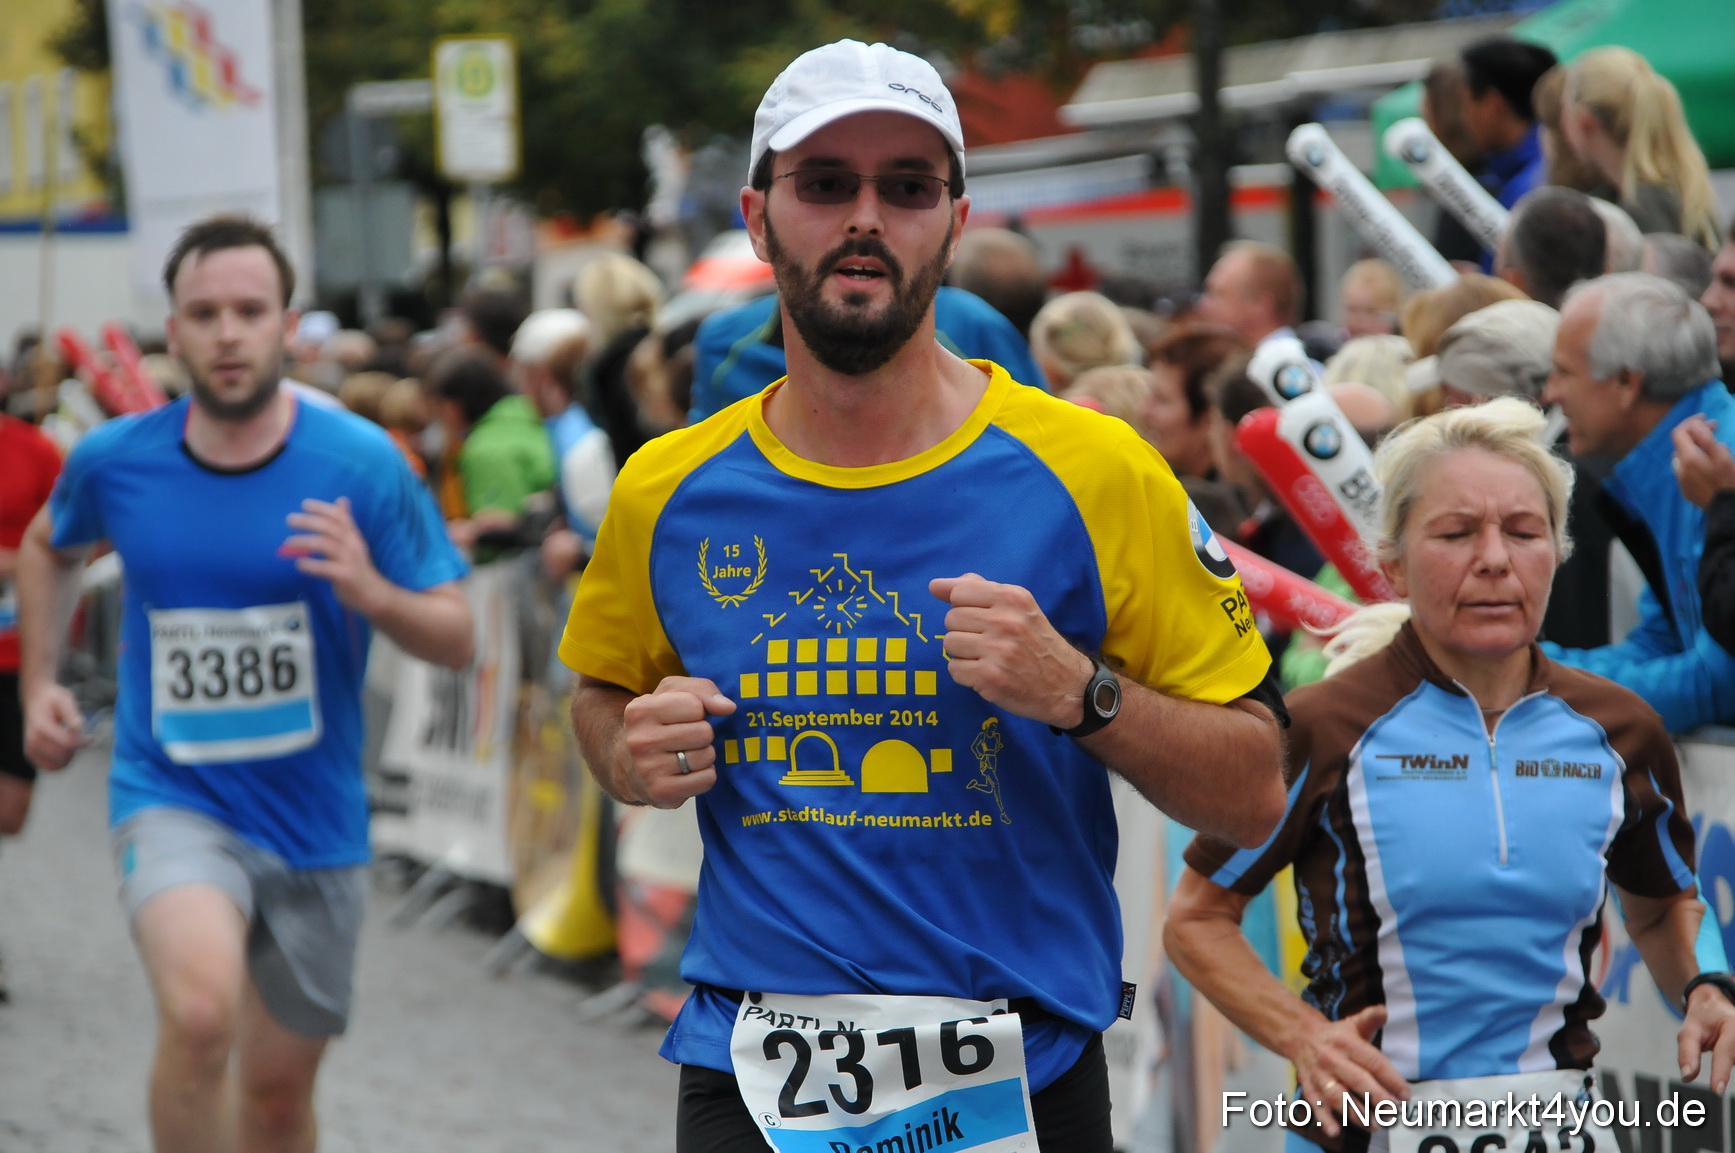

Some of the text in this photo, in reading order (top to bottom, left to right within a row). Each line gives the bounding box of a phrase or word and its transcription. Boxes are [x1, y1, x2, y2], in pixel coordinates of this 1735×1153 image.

[888, 83, 942, 113] orca
[723, 544, 740, 558] 15
[712, 564, 752, 580] Jahre
[1220, 582, 1248, 622] PA
[168, 643, 297, 700] 3386
[746, 709, 939, 729] 21.September 2014
[1562, 760, 1603, 780] RACER
[741, 806, 993, 828] www.stadtlauf-neumarkt.de
[762, 1017, 996, 1119] 2316
